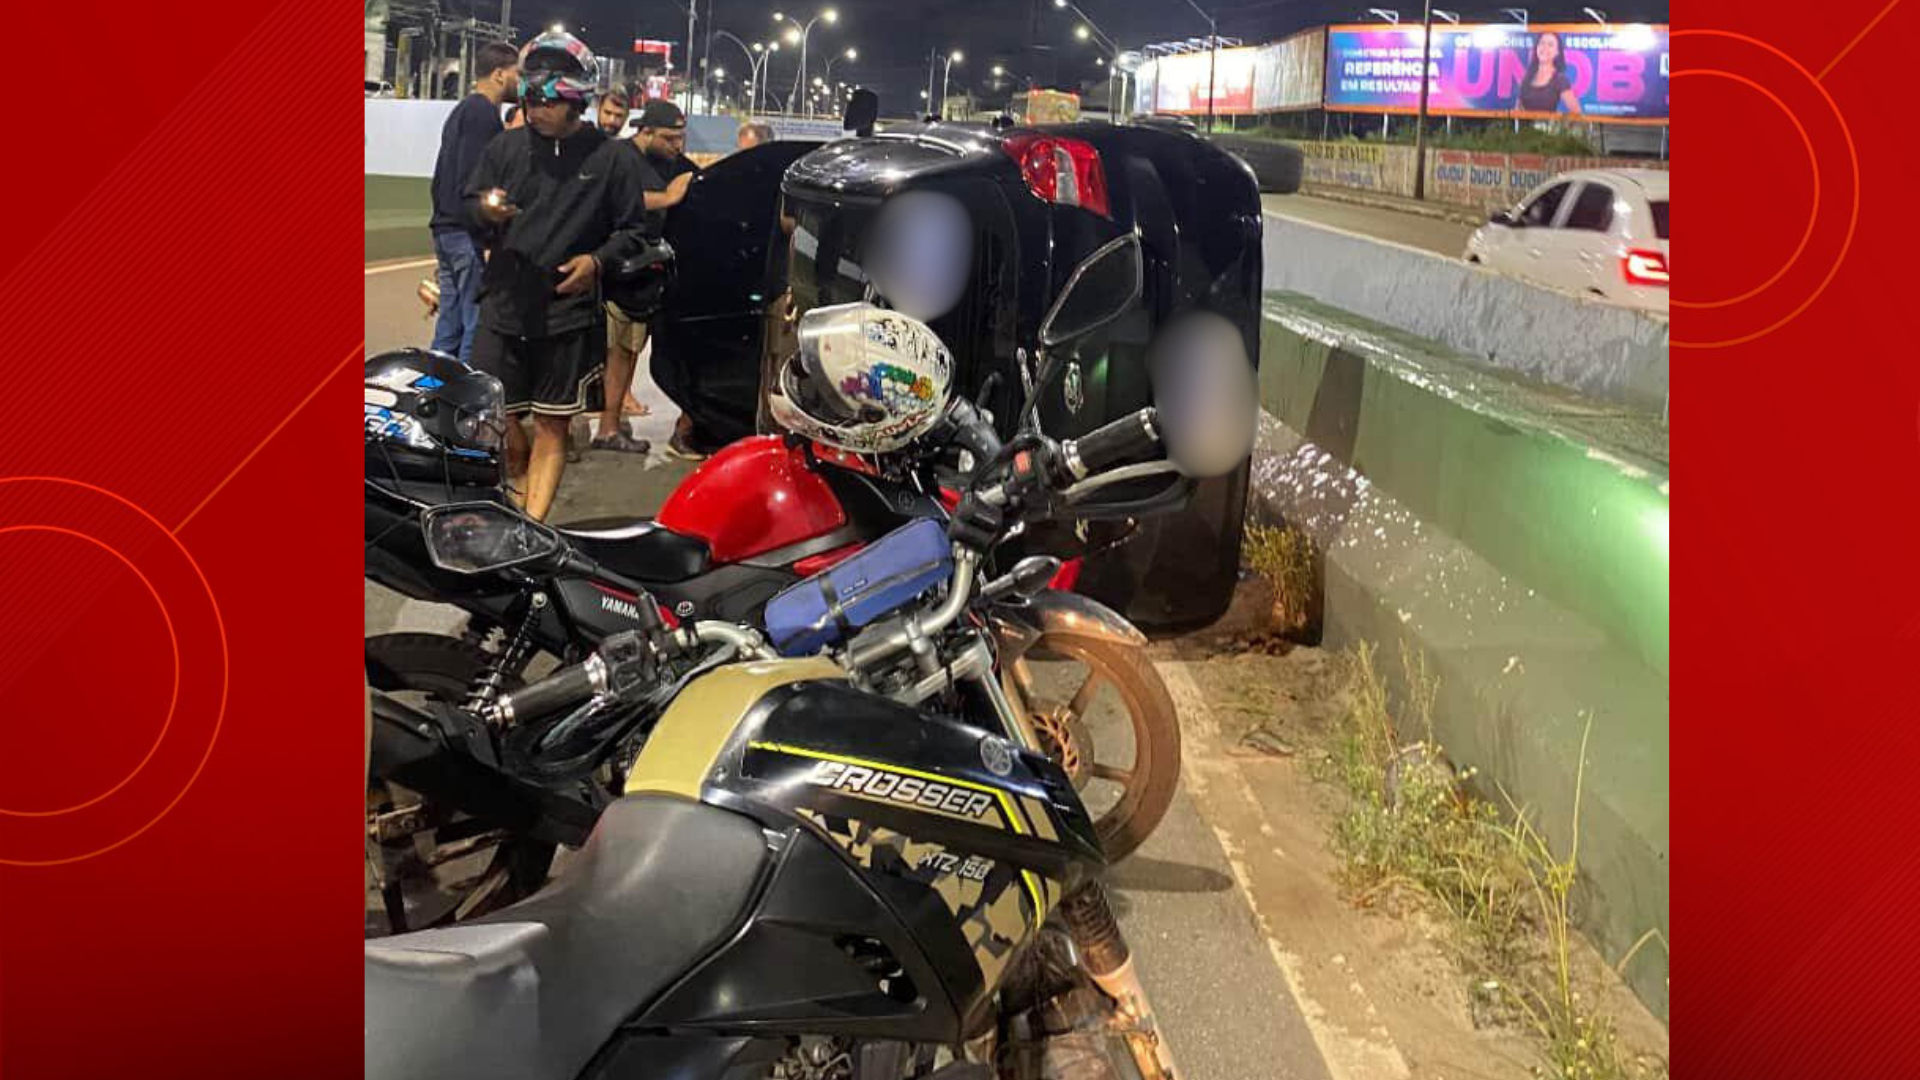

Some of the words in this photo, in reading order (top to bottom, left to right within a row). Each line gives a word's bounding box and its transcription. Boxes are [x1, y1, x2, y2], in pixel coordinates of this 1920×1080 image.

[1344, 60, 1440, 77] REFERÊNCA
[812, 760, 993, 818] CROSSER
[919, 852, 960, 871] XTZ
[959, 855, 995, 880] 150
